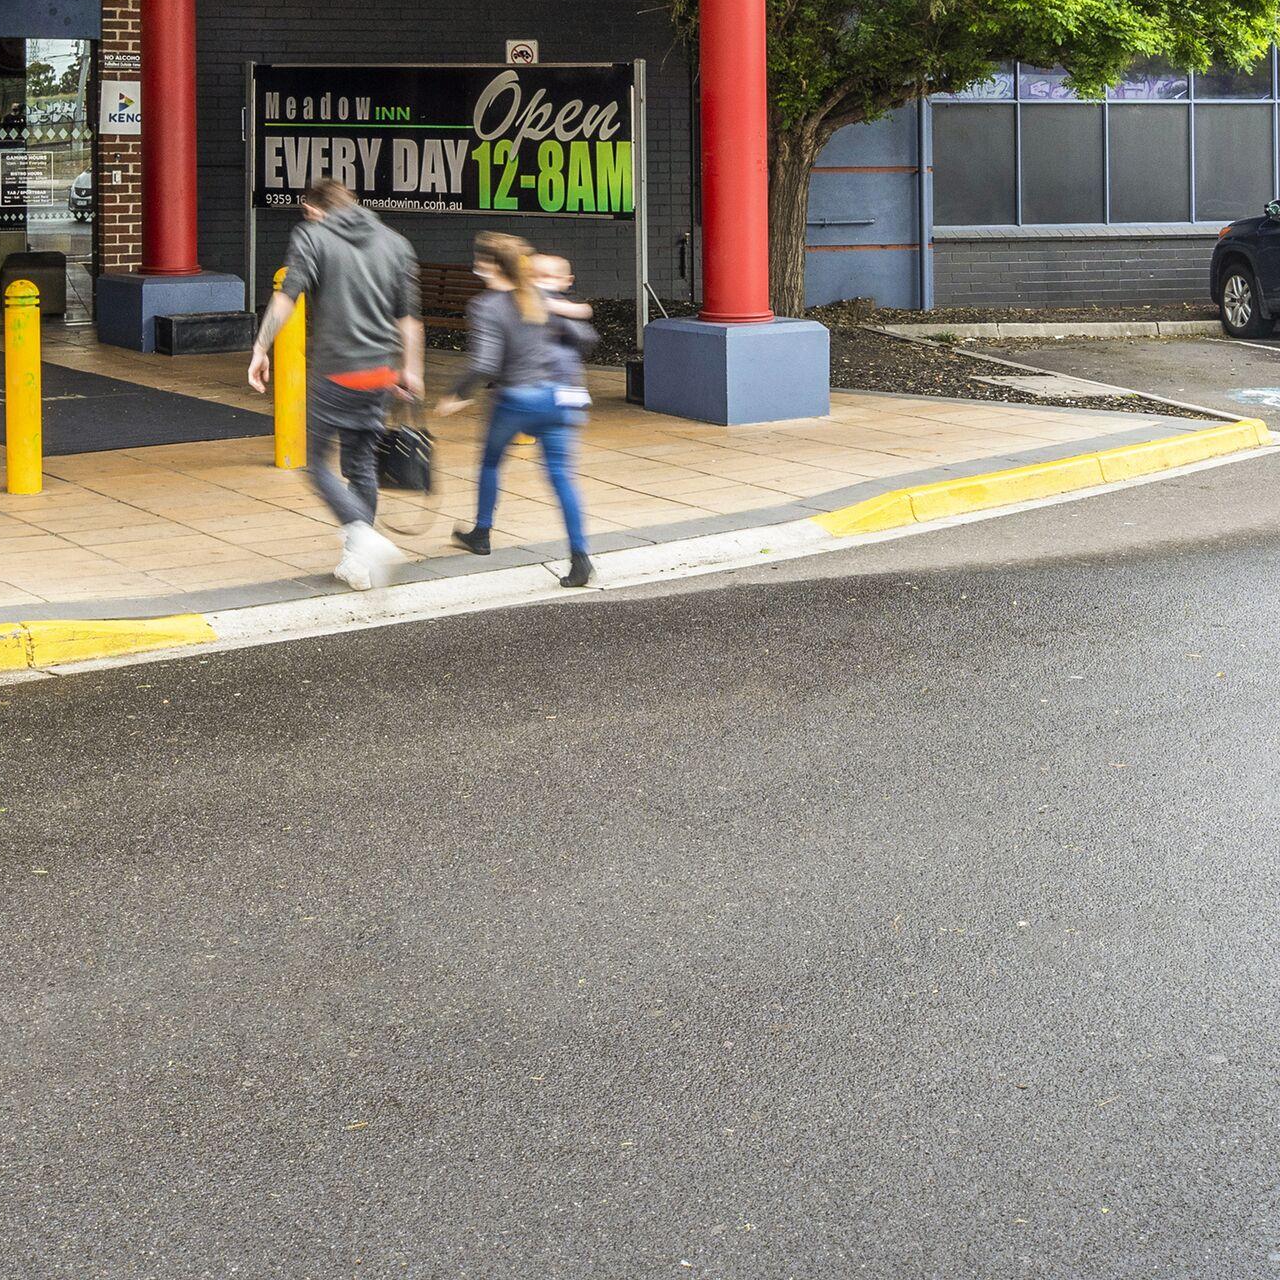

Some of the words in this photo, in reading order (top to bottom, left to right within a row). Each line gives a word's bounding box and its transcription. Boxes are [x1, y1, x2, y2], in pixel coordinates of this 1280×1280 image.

[264, 91, 371, 121] Meadow
[375, 106, 411, 121] INN
[473, 70, 621, 162] Open
[264, 136, 383, 192] EVERY
[392, 138, 470, 194] DAY
[471, 139, 634, 213] 12-8AM
[265, 193, 292, 205] 9359
